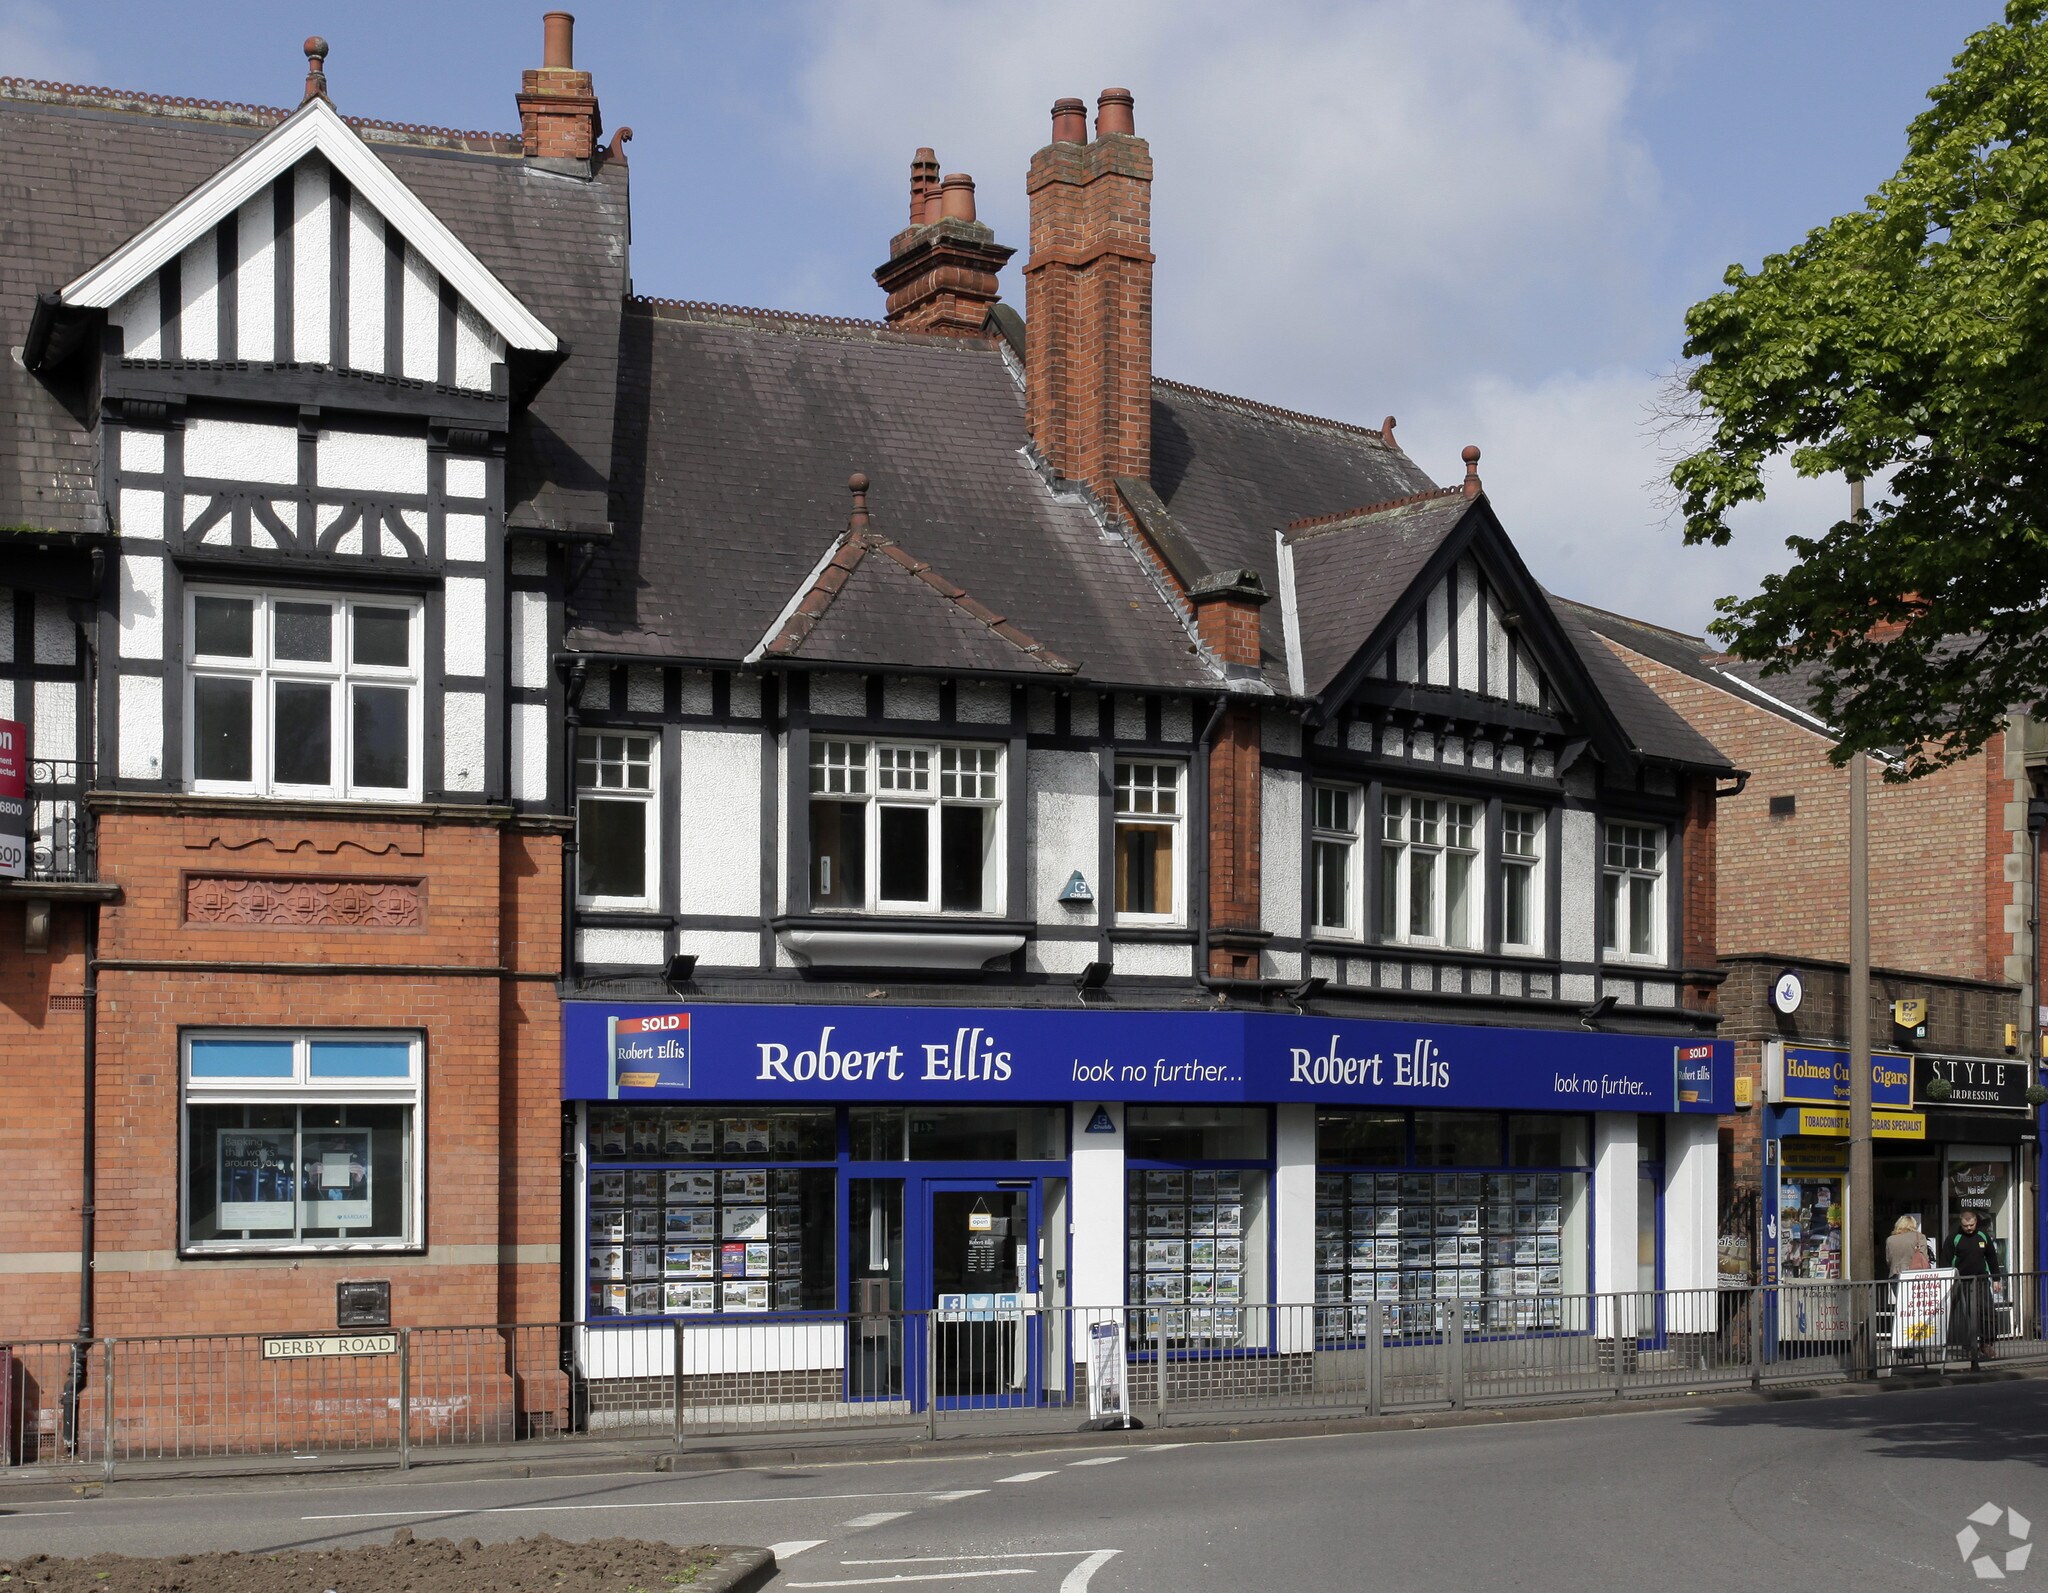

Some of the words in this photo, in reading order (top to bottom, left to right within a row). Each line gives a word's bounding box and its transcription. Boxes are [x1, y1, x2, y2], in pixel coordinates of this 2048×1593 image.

[0, 801, 23, 815] 6800
[641, 1015, 680, 1031] SOLD
[617, 1041, 654, 1060] Robert
[657, 1039, 685, 1059] Ellis
[756, 1026, 905, 1082] Robert
[920, 1027, 1012, 1081] Ellis
[1689, 1047, 1708, 1059] SOLD
[1289, 1034, 1384, 1086] Robert
[1393, 1038, 1450, 1088] Ellis
[1072, 1058, 1115, 1082] look
[1121, 1065, 1147, 1082] no
[1153, 1058, 1242, 1087] further...
[1678, 1066, 1696, 1080] Robert
[1696, 1065, 1710, 1080] Ellis
[1786, 1058, 1831, 1079] Holmes
[1872, 1065, 1908, 1088] Cigars
[1932, 1060, 2006, 1086] STYLE
[1554, 1072, 1580, 1093] look
[1582, 1079, 1598, 1094] no
[1601, 1074, 1652, 1099] further...
[1805, 1115, 1844, 1129] TOBACCONIST
[1871, 1118, 1891, 1131] CIGARS
[1892, 1120, 1923, 1132] SPECIALIST
[225, 1137, 263, 1149] Banking
[225, 1158, 259, 1168] around
[269, 1339, 326, 1355] DERBY
[338, 1337, 391, 1352] ROAD
